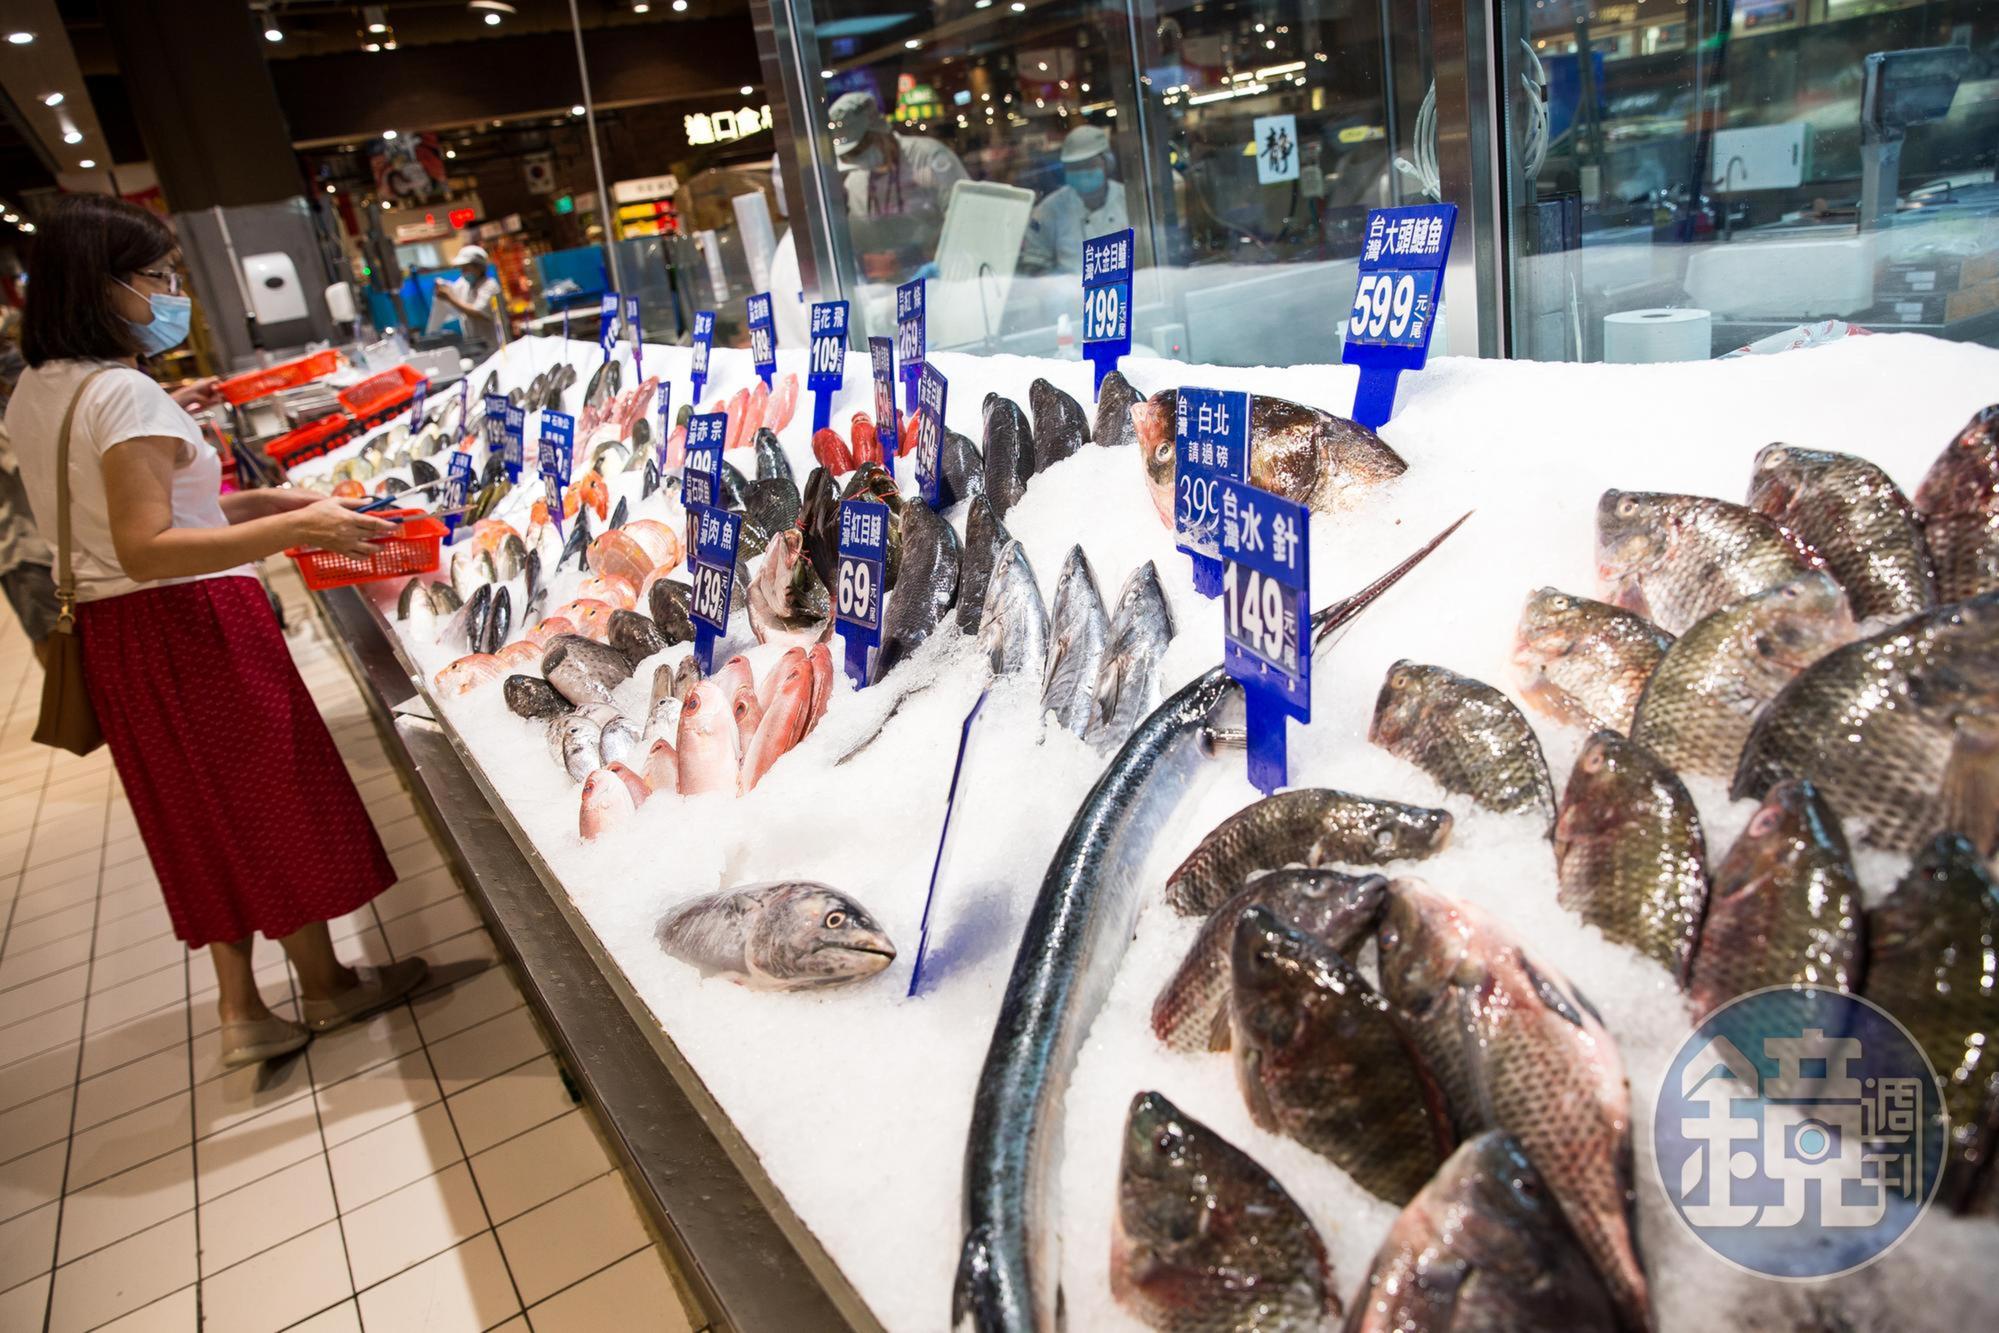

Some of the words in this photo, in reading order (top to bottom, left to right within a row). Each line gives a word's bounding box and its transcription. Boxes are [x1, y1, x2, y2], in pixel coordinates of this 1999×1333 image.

[1364, 214, 1386, 262] 台灣
[1084, 244, 1094, 281] 台灣
[1085, 288, 1118, 338] 199
[1351, 274, 1415, 338] 599
[813, 336, 839, 373] 109
[899, 319, 918, 360] 269
[686, 417, 698, 445] 台灣
[697, 419, 722, 442] 赤宗
[1177, 395, 1188, 437] 台灣
[1198, 402, 1230, 436] 白北
[1188, 441, 1229, 469] 請過磅
[700, 510, 710, 547] 台灣
[708, 517, 732, 550] 肉魚
[840, 506, 851, 548] 台灣
[1222, 487, 1240, 553] 台灣
[1240, 502, 1299, 569] 水針
[695, 566, 721, 619] 139
[838, 560, 870, 618] 69
[1223, 560, 1284, 660] 149
